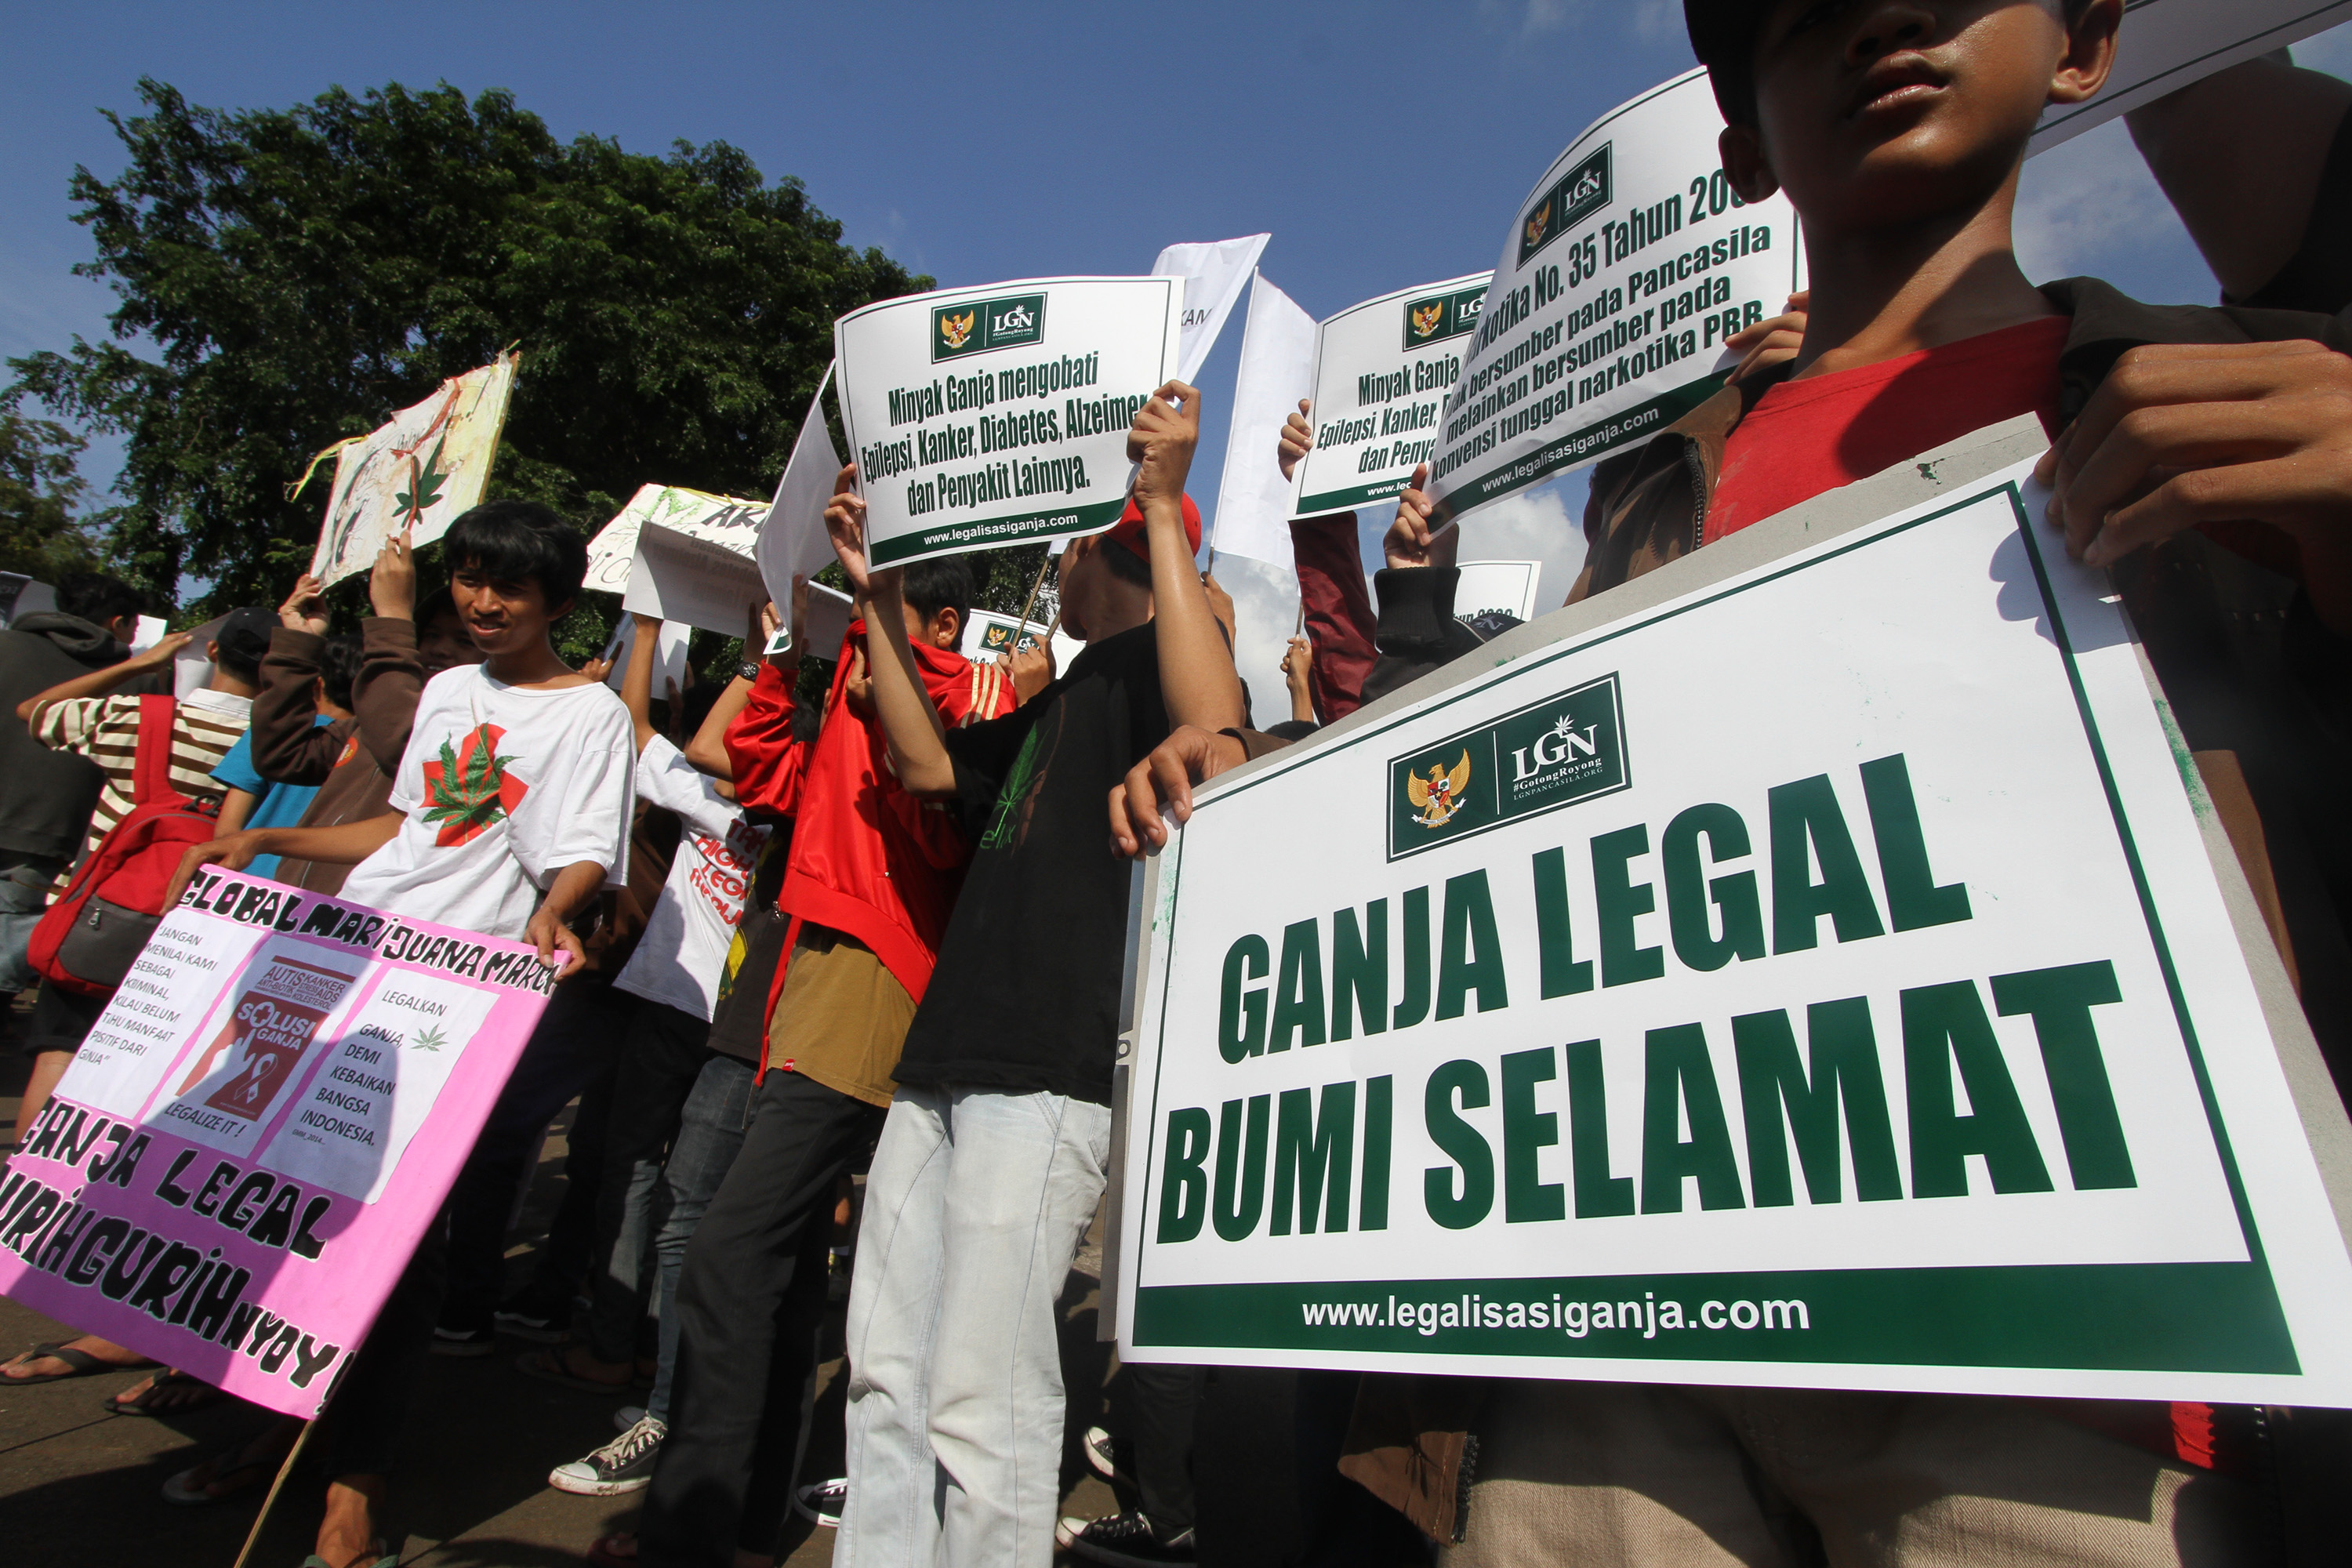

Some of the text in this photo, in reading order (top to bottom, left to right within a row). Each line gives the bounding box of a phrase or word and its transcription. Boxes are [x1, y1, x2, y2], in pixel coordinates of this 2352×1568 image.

[1565, 170, 1602, 212] LGN
[1534, 264, 1565, 312] No.
[1569, 232, 1596, 289] 35
[1602, 194, 1681, 269] Tahun
[1690, 168, 1747, 226] 20
[993, 310, 1035, 332] LGN
[1459, 297, 1484, 319] LG
[1468, 318, 1564, 399] bersumber
[1568, 287, 1623, 341] pada
[1628, 224, 1771, 300] Pancasila
[1446, 276, 1731, 445] melainkan bersumber pada
[887, 350, 1100, 426] Minyak Ganja mengobati
[1358, 365, 1411, 407] Minyak
[1414, 354, 1460, 394] Ganja
[1430, 420, 1497, 485] konvensi
[1501, 380, 1575, 443] tunggal
[1579, 329, 1696, 405] narkotika
[862, 436, 916, 483] Epilepsi,
[918, 418, 978, 467] Kanker,
[979, 402, 1063, 454] Diabetes,
[1316, 411, 1377, 451] Epilepsi,
[1380, 401, 1438, 437] Kanker,
[1358, 437, 1438, 474] dan Penya
[1482, 408, 1660, 492] www.legalisasiganja.com
[907, 455, 1091, 517] dan Penyakit Lainnya.
[924, 513, 1079, 546] www.legalisasiganja.com
[1512, 724, 1599, 782] LGN
[1513, 757, 1602, 792] #GotongRoyong
[1513, 768, 1603, 800] LGNPANCASILA.ORG
[1218, 752, 1973, 1065] GANJA LEGAL
[133, 960, 176, 979] SEBAGAI
[144, 942, 218, 971] MENILAI KAMI
[256, 979, 296, 994] ANTI-BIOTIK
[298, 982, 320, 993] STRESS
[315, 988, 340, 1003] AIDS
[263, 965, 307, 986] AUTIS
[303, 975, 346, 993] KANKER
[141, 1004, 181, 1023] BELUM
[292, 992, 332, 1011] KOLESTEROL
[382, 989, 448, 1017] LEGALKAN
[123, 1019, 176, 1042] MANFAAT
[237, 1001, 317, 1038] SOLUSI
[359, 1023, 405, 1048] GANJA,
[119, 1039, 148, 1057] DARI
[256, 1028, 303, 1051] GANJA
[344, 1044, 382, 1065] DEMI
[330, 1065, 396, 1096] KEBAIKAN
[164, 1102, 224, 1130] LEGALIZE
[220, 1120, 238, 1134] IT
[315, 1087, 371, 1116] BANGSA
[1156, 958, 2138, 1245] BUMI SELAMAT
[300, 1109, 375, 1146] INDONESIA.
[154, 1148, 332, 1262] LEGAL
[1301, 1292, 1811, 1341] www.legalisasiganja.com
